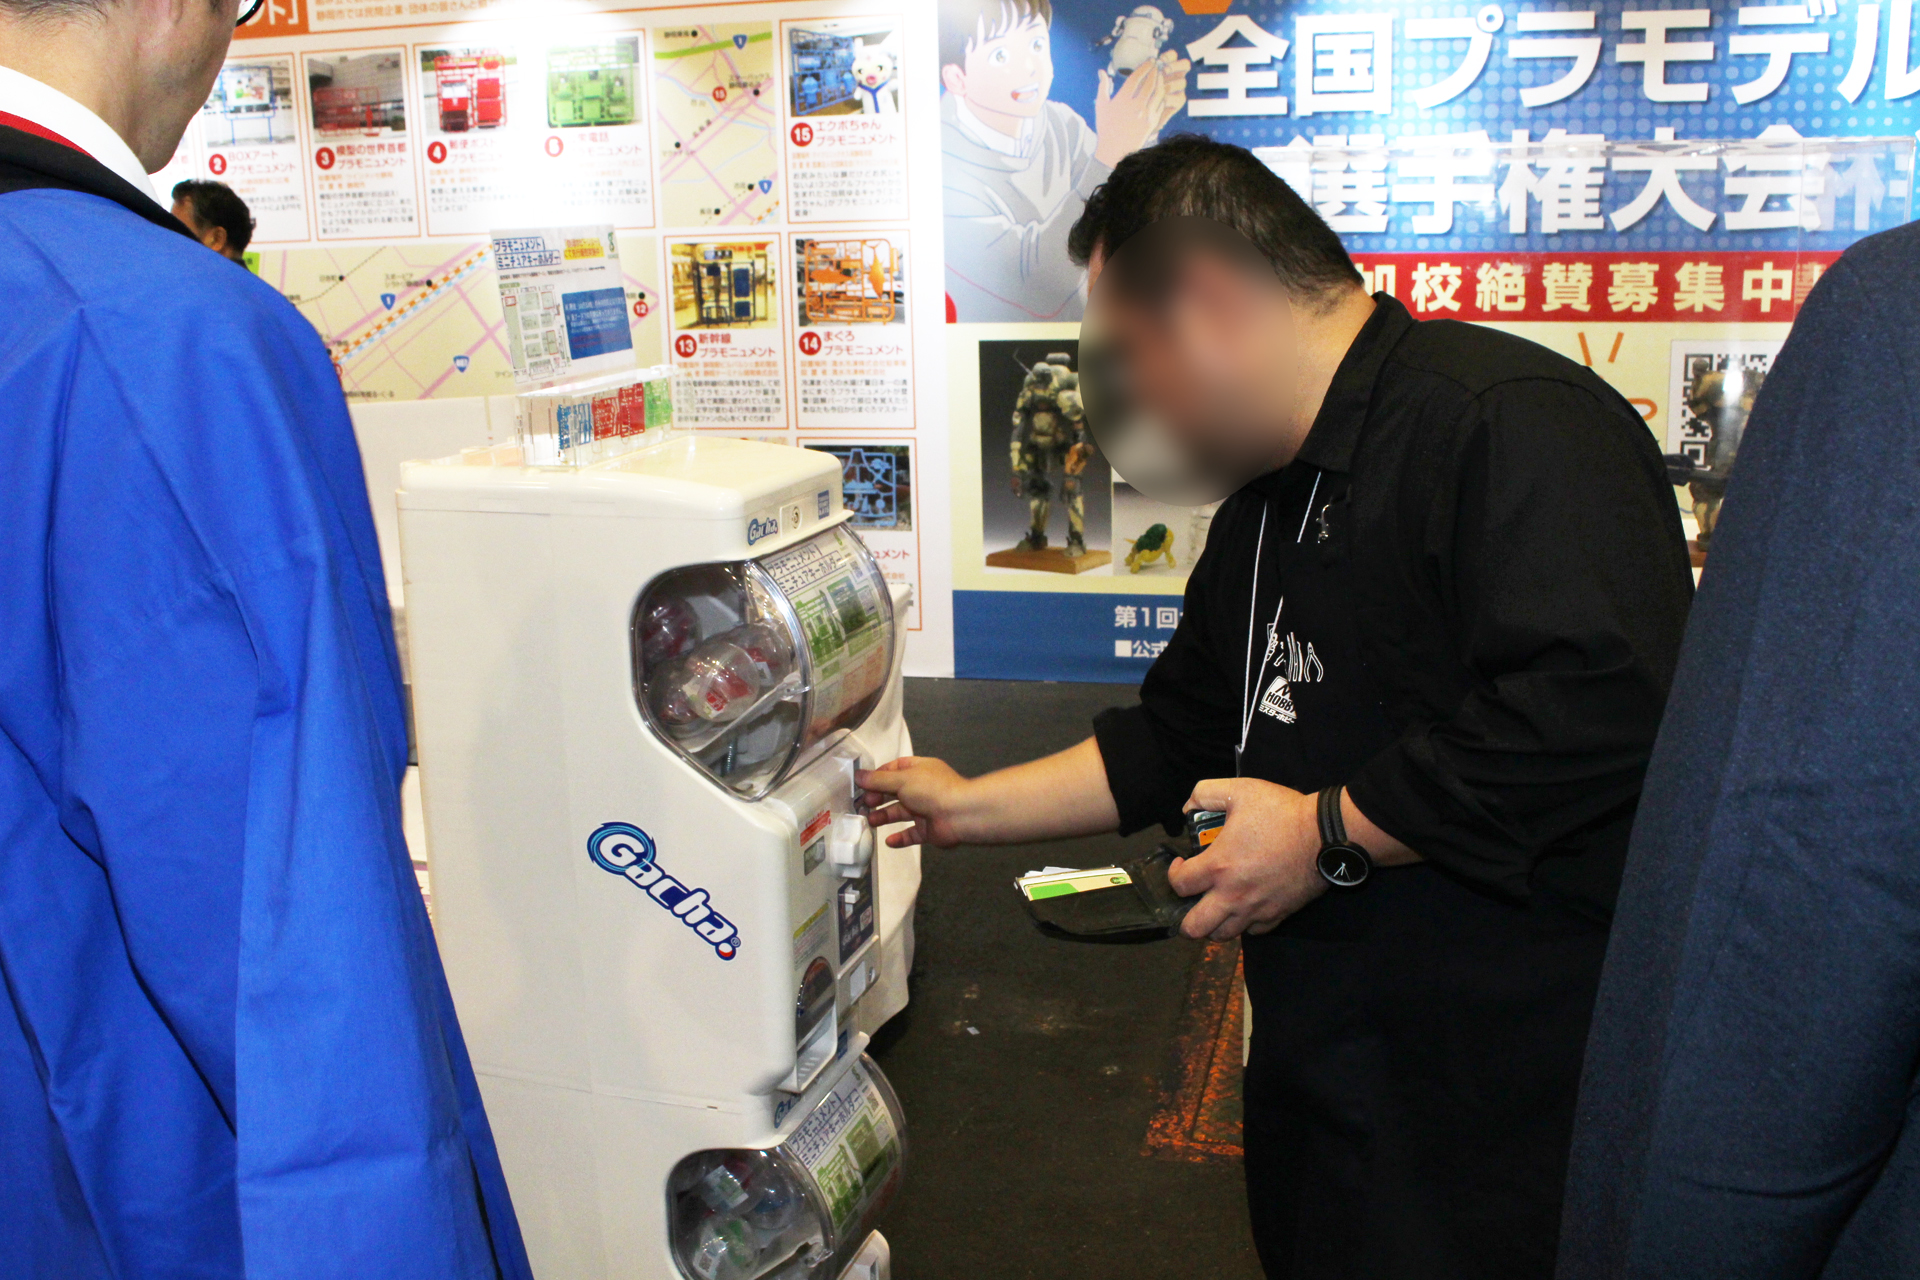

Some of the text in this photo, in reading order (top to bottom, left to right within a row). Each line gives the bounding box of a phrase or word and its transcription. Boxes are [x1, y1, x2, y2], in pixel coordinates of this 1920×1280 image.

[1185, 0, 1920, 117] 全国プラモデル
[816, 120, 881, 132] エクボちゃん
[794, 127, 811, 142] 15
[816, 134, 897, 147] プラモニュメント
[213, 158, 222, 171] 2
[321, 152, 330, 165] 3
[337, 157, 408, 170] プラモニュメント
[229, 163, 297, 175] プラモニュメント
[1252, 124, 1831, 234] 選手権大会
[635, 303, 647, 314] 12
[698, 333, 732, 344] 新幹線
[823, 330, 855, 342] まぐろ
[678, 338, 695, 353] 13
[802, 336, 819, 351] 14
[699, 346, 776, 359] プラモニュメント
[823, 344, 904, 357] プラモニュメント
[1114, 606, 1184, 629] 第1回
[587, 822, 739, 948] Gacha
